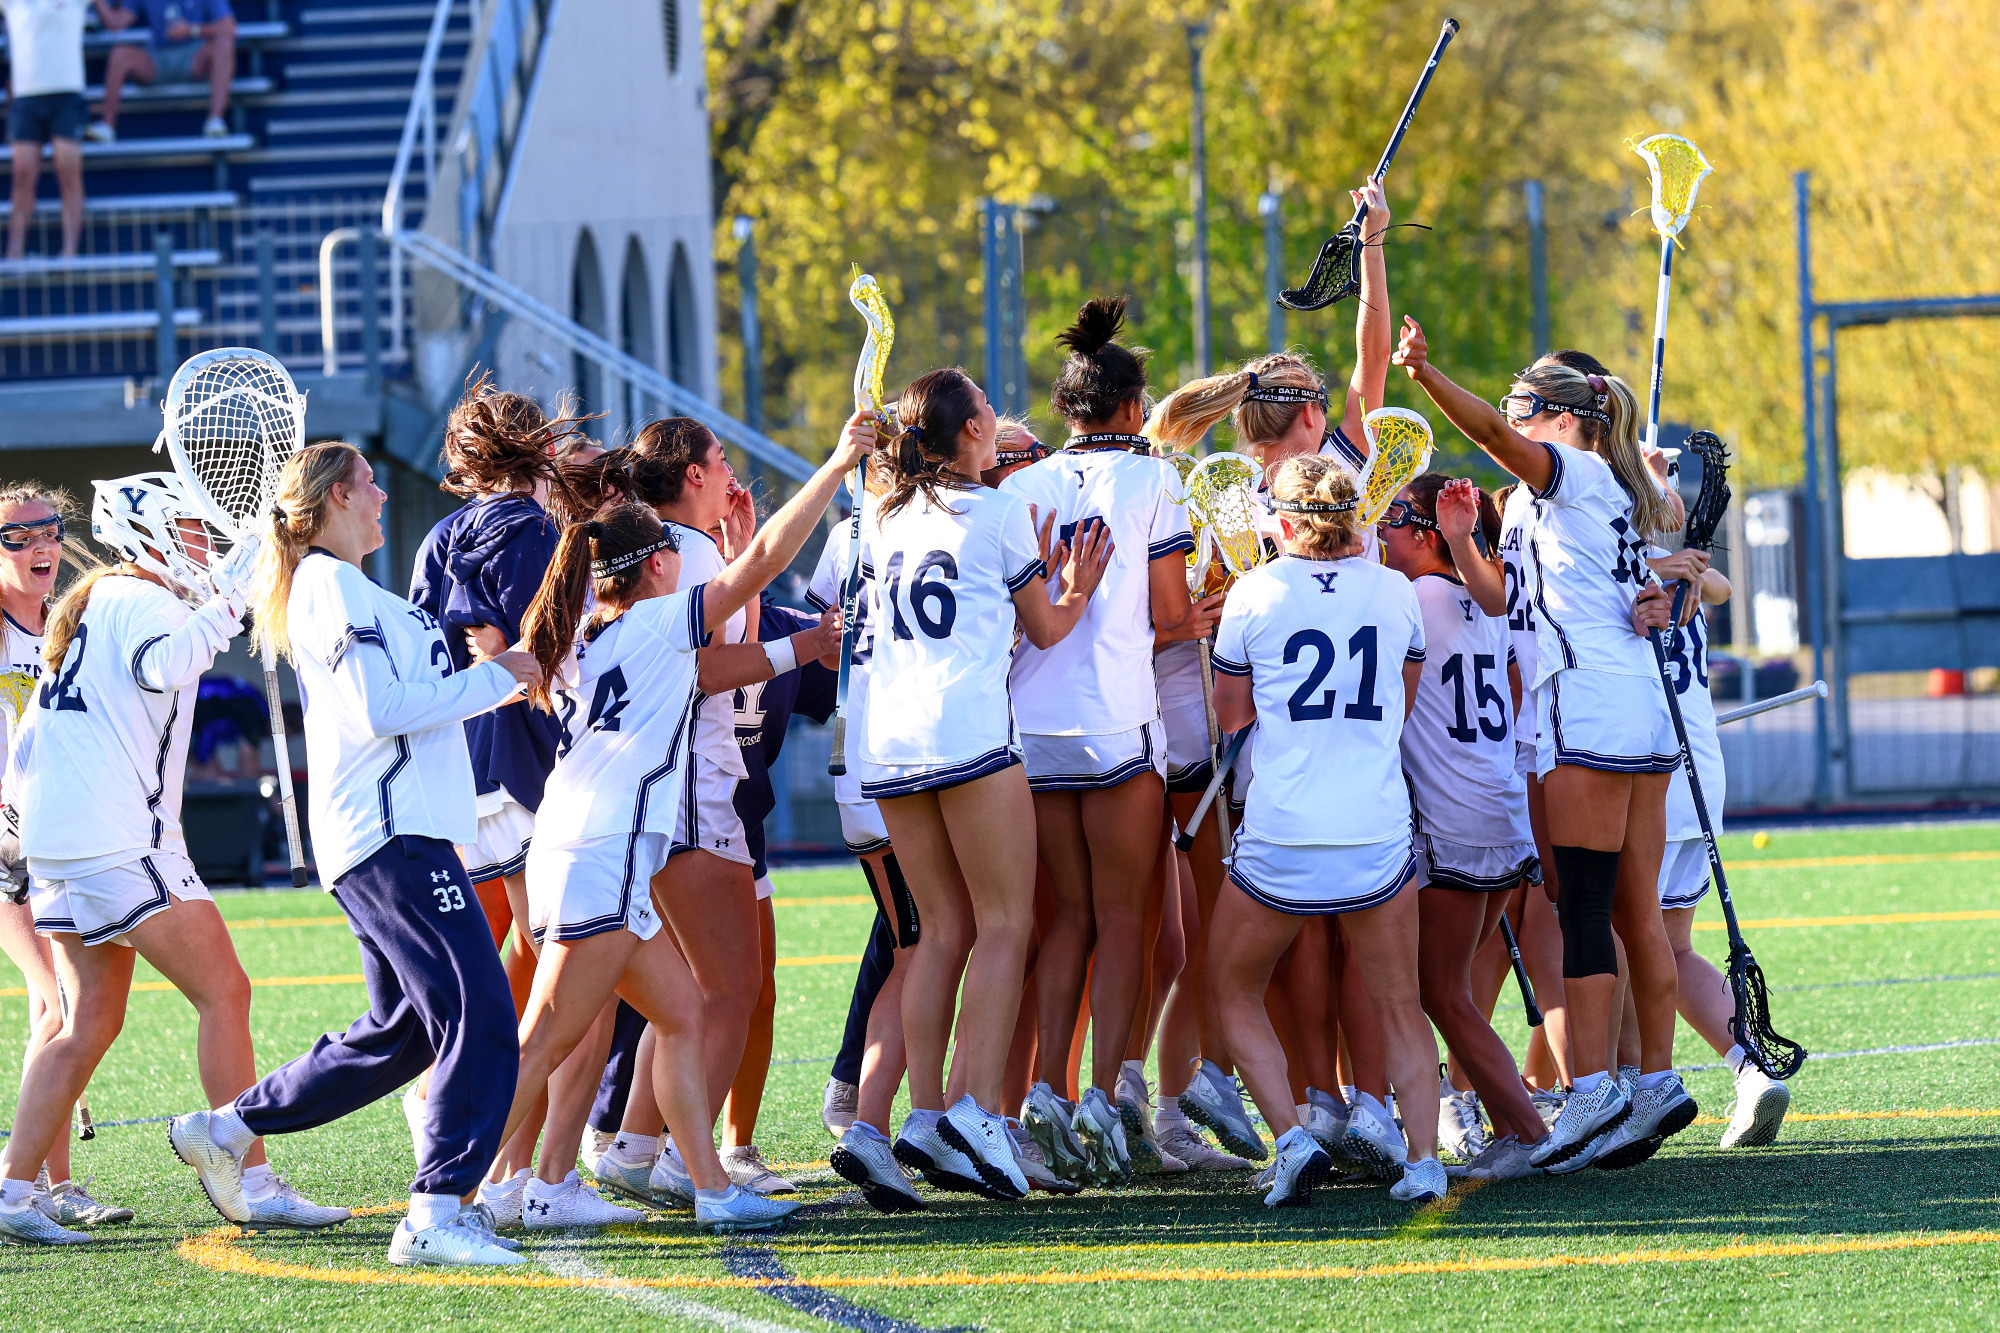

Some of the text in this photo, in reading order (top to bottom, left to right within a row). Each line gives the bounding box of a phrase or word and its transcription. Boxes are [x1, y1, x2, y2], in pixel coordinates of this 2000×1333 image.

[1301, 390, 1317, 399] GAIT
[1547, 403, 1592, 417] GAIT GAIT
[1091, 434, 1113, 442] GAIT
[118, 487, 149, 516] Y
[1302, 503, 1324, 511] GAIT
[1328, 502, 1349, 511] GAIT
[850, 505, 862, 540] GAIT
[1410, 514, 1433, 527] GAIT
[612, 552, 633, 564] GAIT
[636, 544, 656, 556] GAIT
[884, 550, 959, 641] 16
[1311, 571, 1339, 594] Y
[844, 597, 856, 635] YALE
[1458, 599, 1474, 622] Y
[1662, 619, 1676, 647] GAIT
[1282, 625, 1383, 723] 21
[1441, 653, 1508, 743] 15
[1680, 741, 1694, 778] YALE
[1703, 830, 1718, 864] GAIT
[432, 885, 466, 913] 33
